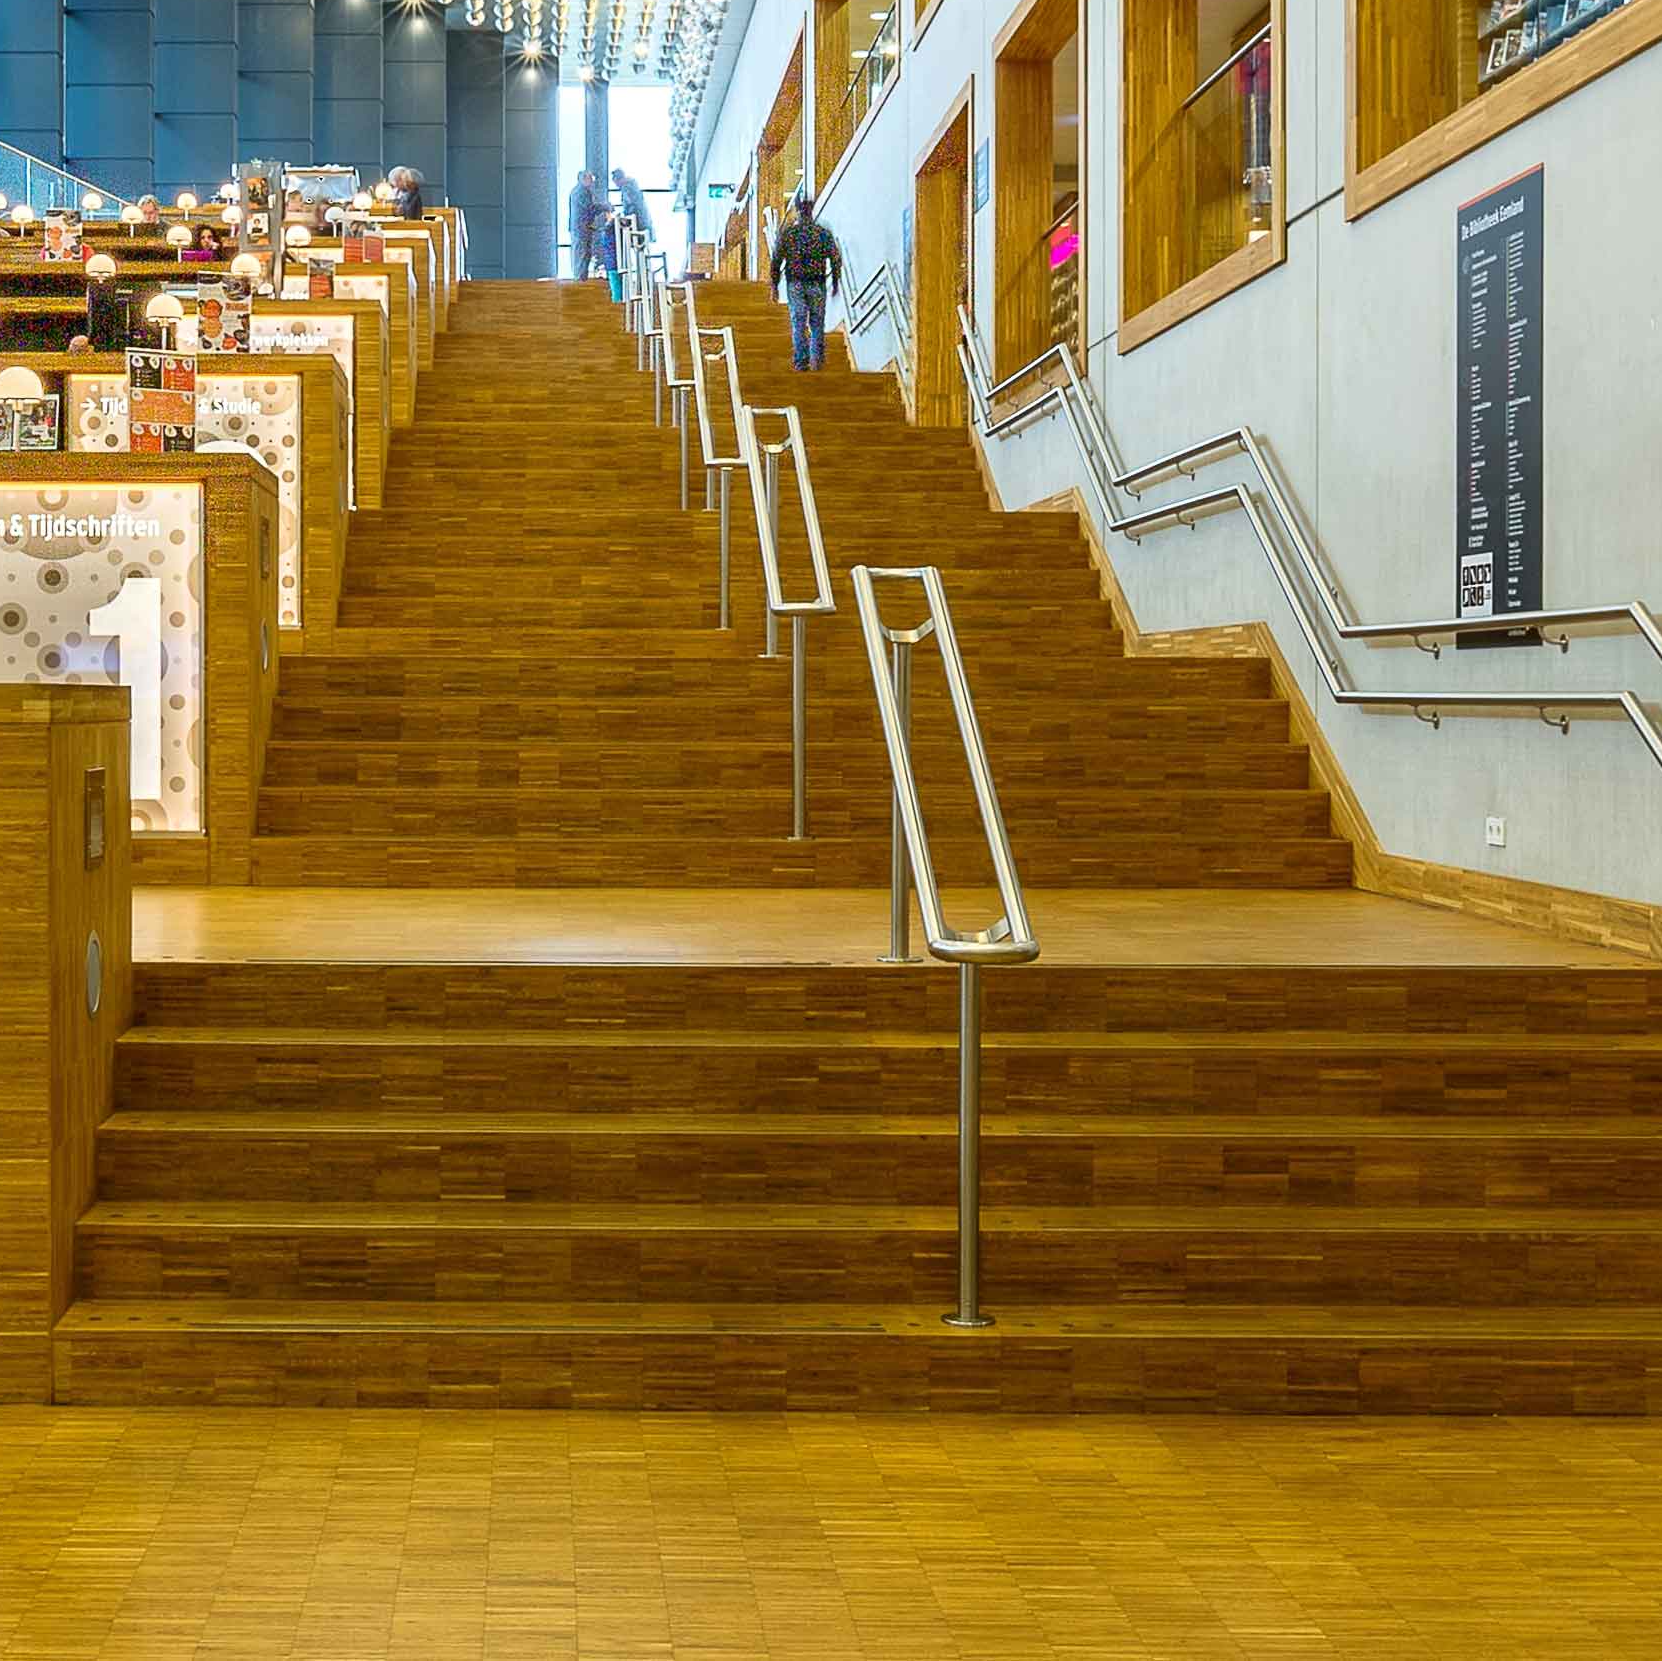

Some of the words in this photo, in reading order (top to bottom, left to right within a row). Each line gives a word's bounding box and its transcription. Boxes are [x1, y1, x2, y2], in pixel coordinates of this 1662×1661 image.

[213, 396, 263, 416] Studie
[9, 514, 24, 538] &
[27, 513, 161, 542] Tijdschriften
[89, 577, 162, 801] 1
